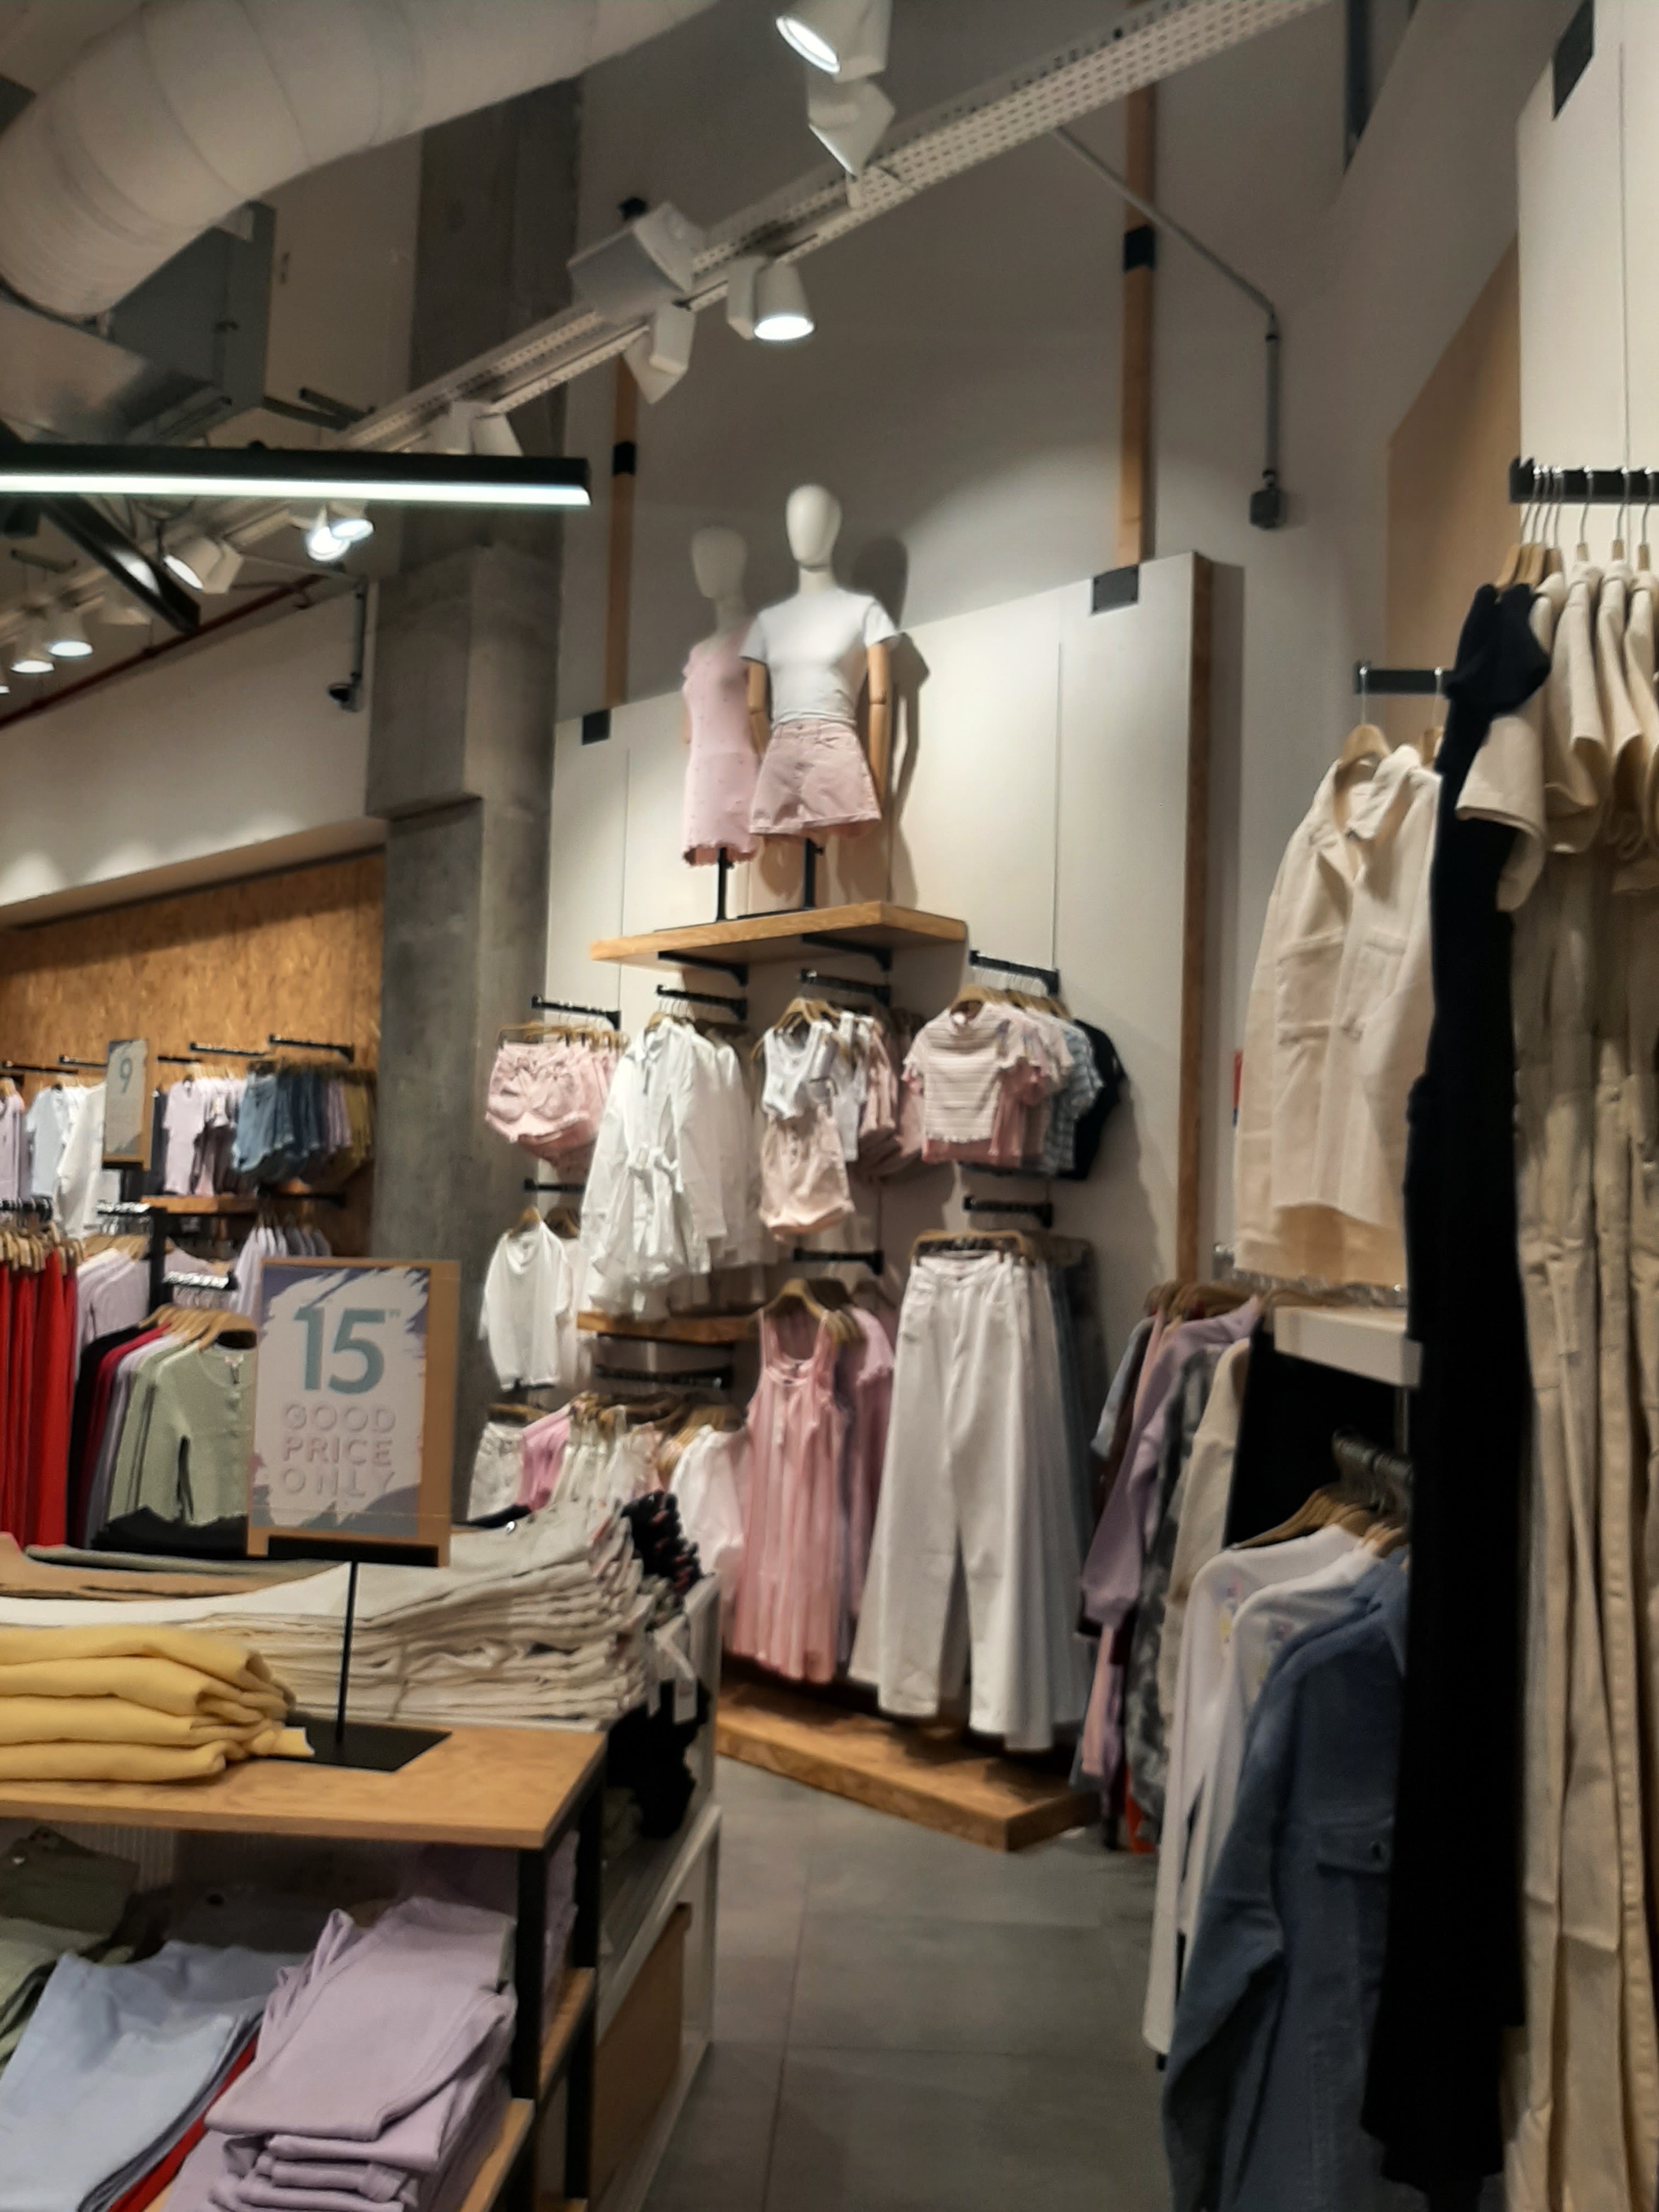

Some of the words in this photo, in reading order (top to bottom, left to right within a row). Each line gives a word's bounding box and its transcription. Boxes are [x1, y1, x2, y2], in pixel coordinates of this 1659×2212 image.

[293, 1306, 386, 1395] 15
[283, 1402, 396, 1433] GOOD
[283, 1435, 393, 1466] PRICE
[281, 1467, 394, 1497] ONLY
